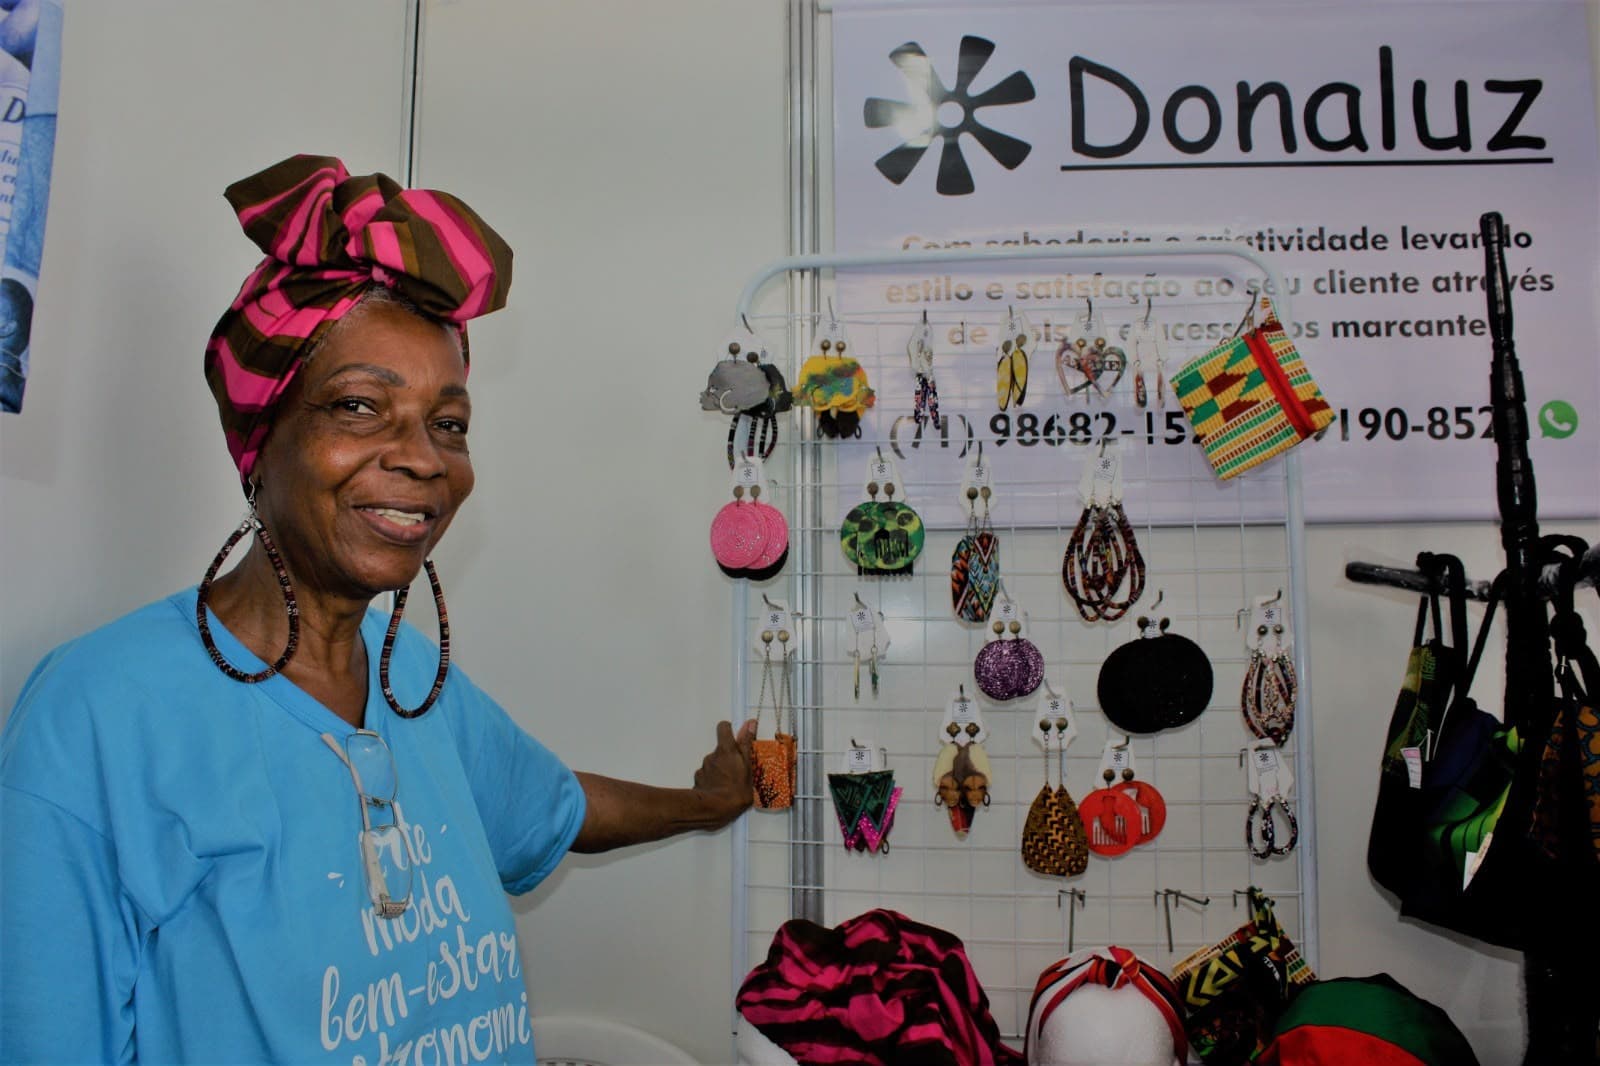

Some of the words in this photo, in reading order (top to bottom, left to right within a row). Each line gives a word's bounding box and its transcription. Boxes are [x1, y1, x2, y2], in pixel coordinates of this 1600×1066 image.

[1068, 45, 1547, 159] Donaluz
[886, 275, 973, 303] estilo
[986, 281, 1004, 300] e
[1016, 271, 1181, 304] satisfação
[1194, 278, 1235, 298] ao
[1313, 268, 1420, 296] cliente
[948, 321, 988, 345] de
[1332, 314, 1487, 338] marcante
[989, 410, 1206, 447] 98682-15
[361, 870, 471, 957] moda
[320, 924, 520, 1051] bem-estar
